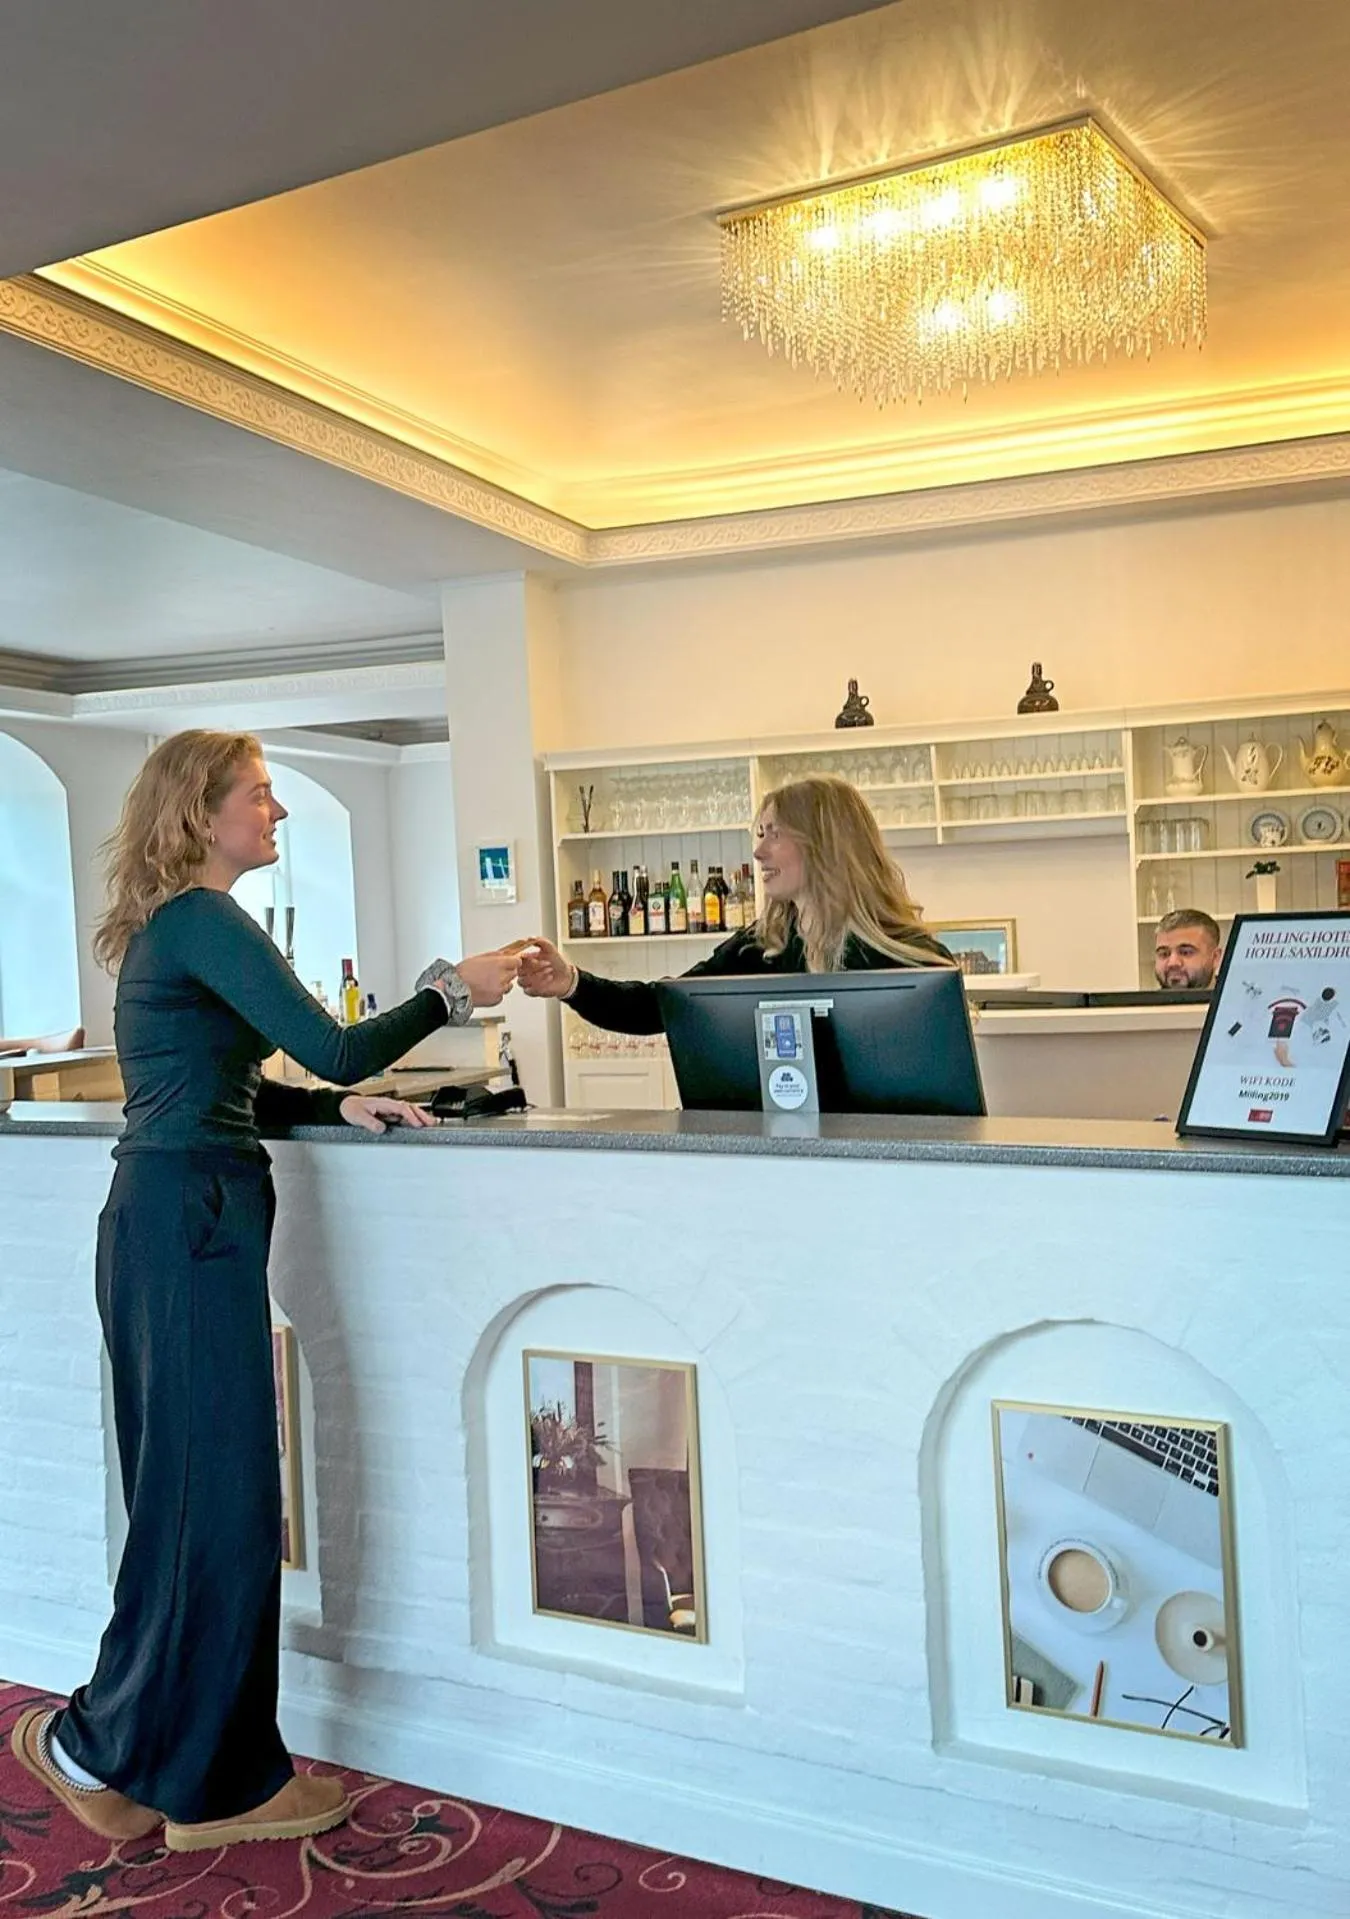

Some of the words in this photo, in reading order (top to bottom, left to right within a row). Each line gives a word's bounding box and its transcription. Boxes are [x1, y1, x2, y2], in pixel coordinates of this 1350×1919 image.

[1252, 931, 1309, 944] MILLING
[1245, 947, 1287, 959] HOTEL
[1240, 1075, 1263, 1085] WIFI
[1264, 1076, 1296, 1087] KODE
[1238, 1090, 1290, 1102] Milling2019
